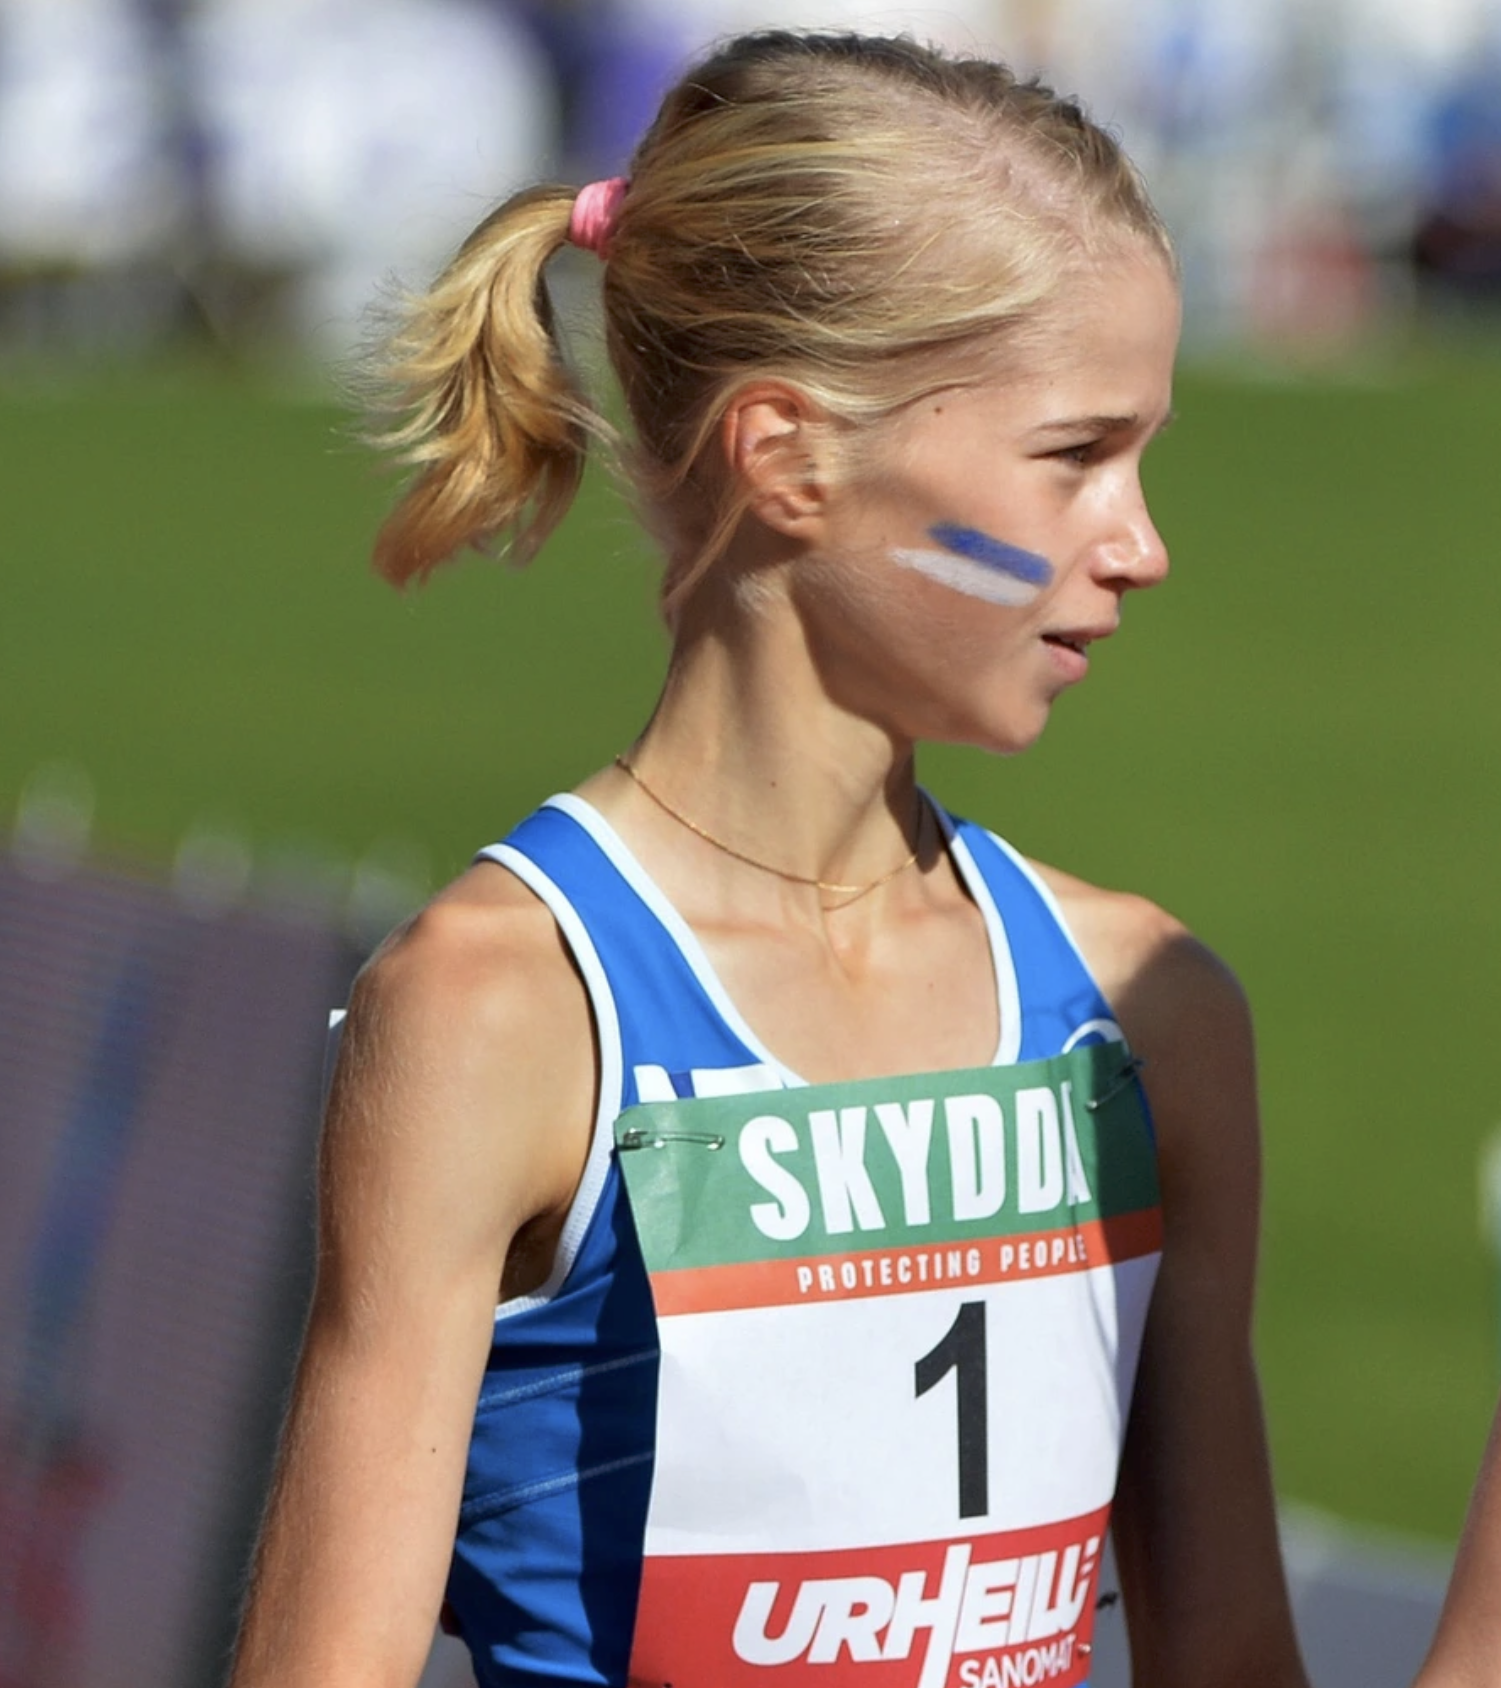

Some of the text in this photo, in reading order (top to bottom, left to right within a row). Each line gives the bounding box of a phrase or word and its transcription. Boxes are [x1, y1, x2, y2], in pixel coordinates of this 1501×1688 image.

[797, 1234, 1088, 1293] PROTECTING PEOPLE
[914, 1299, 988, 1520] 1
